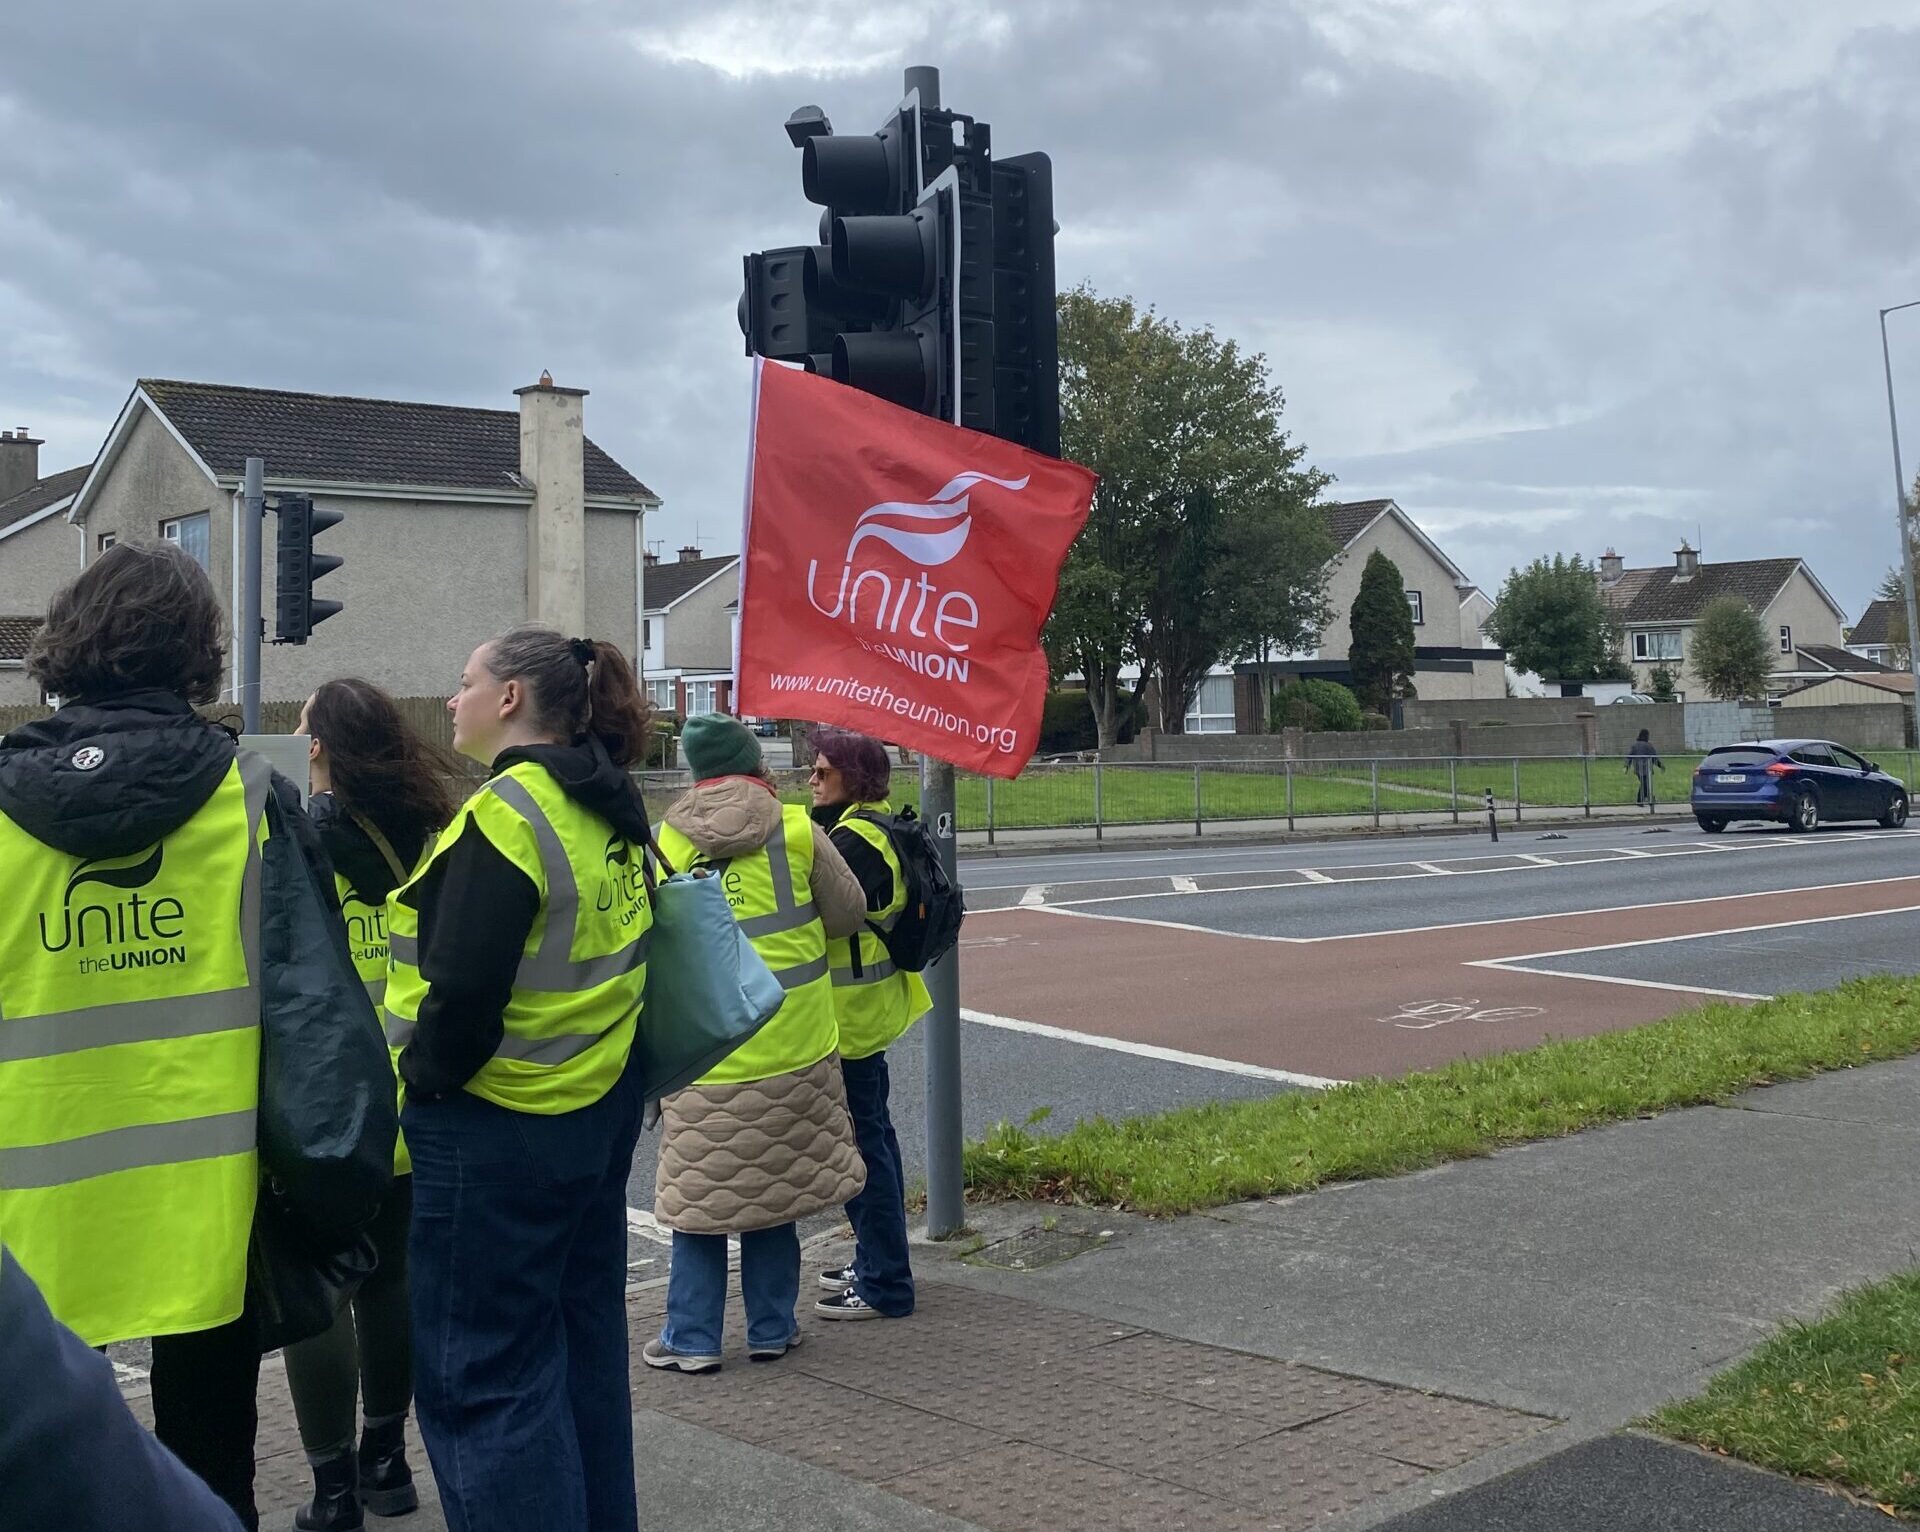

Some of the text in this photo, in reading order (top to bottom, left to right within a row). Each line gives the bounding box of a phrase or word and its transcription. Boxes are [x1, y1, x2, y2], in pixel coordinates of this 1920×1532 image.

[807, 559, 979, 652] unite
[769, 673, 1017, 753] www.unitetheunion.org
[595, 863, 644, 912] unite
[38, 892, 185, 953] unite
[347, 909, 388, 943] nit
[78, 946, 187, 975] theUNION
